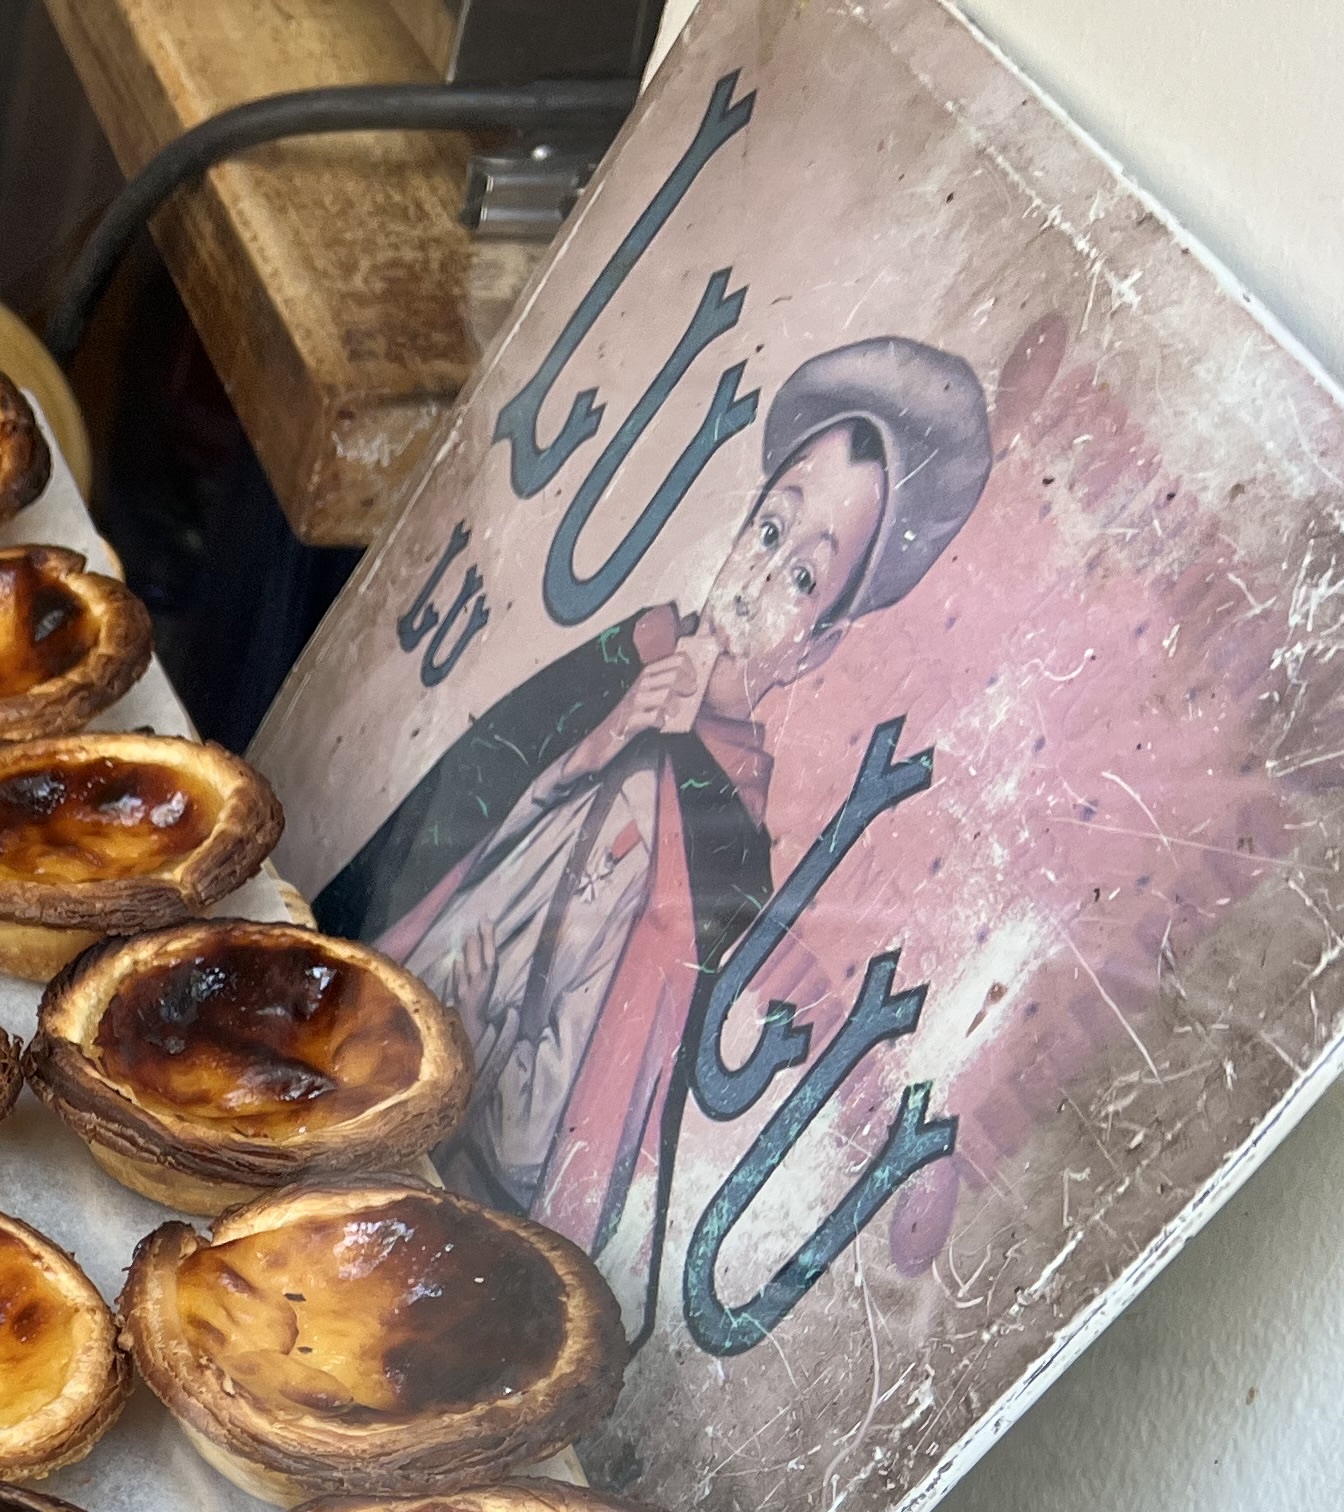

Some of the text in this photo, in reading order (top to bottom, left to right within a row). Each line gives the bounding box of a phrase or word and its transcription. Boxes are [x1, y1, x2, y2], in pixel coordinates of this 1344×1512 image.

[396, 518, 490, 687] LU
[492, 67, 761, 627] LU
[681, 715, 958, 1357] LU
